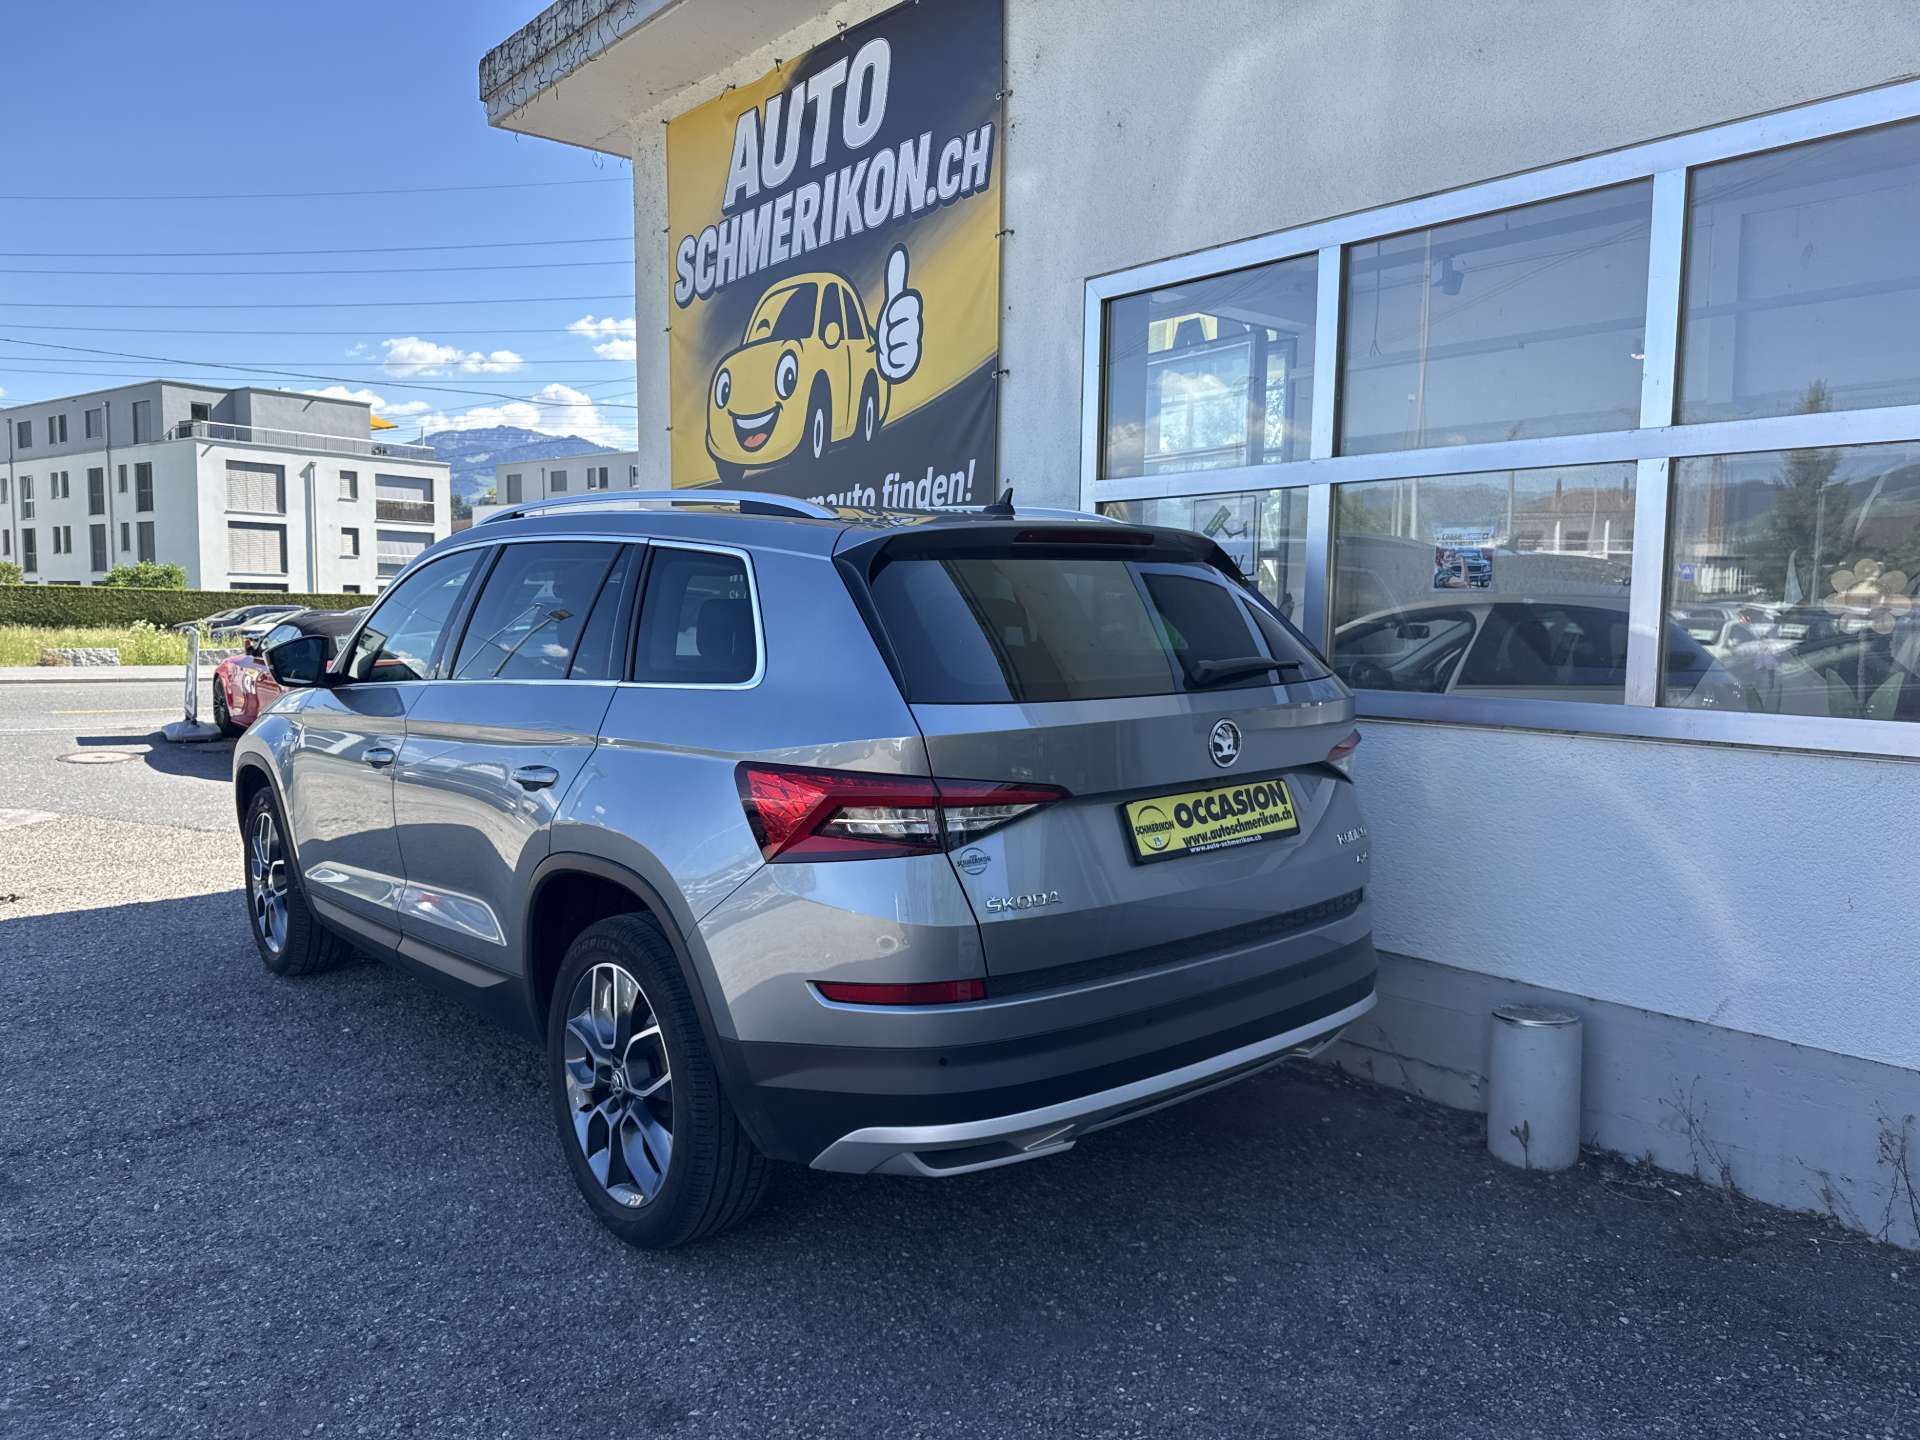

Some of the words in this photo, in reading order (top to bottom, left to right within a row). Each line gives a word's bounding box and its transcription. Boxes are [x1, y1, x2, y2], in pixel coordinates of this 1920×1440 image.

[722, 37, 891, 211] AUTO
[674, 122, 993, 305] SCHMERIKON.CH
[882, 458, 976, 508] finden!
[1135, 819, 1175, 836] SCHMERIKON
[1174, 781, 1288, 829] OCCASION
[1182, 806, 1293, 848] www.autoschmerikon.ch
[986, 890, 1062, 913] ŠKODA
